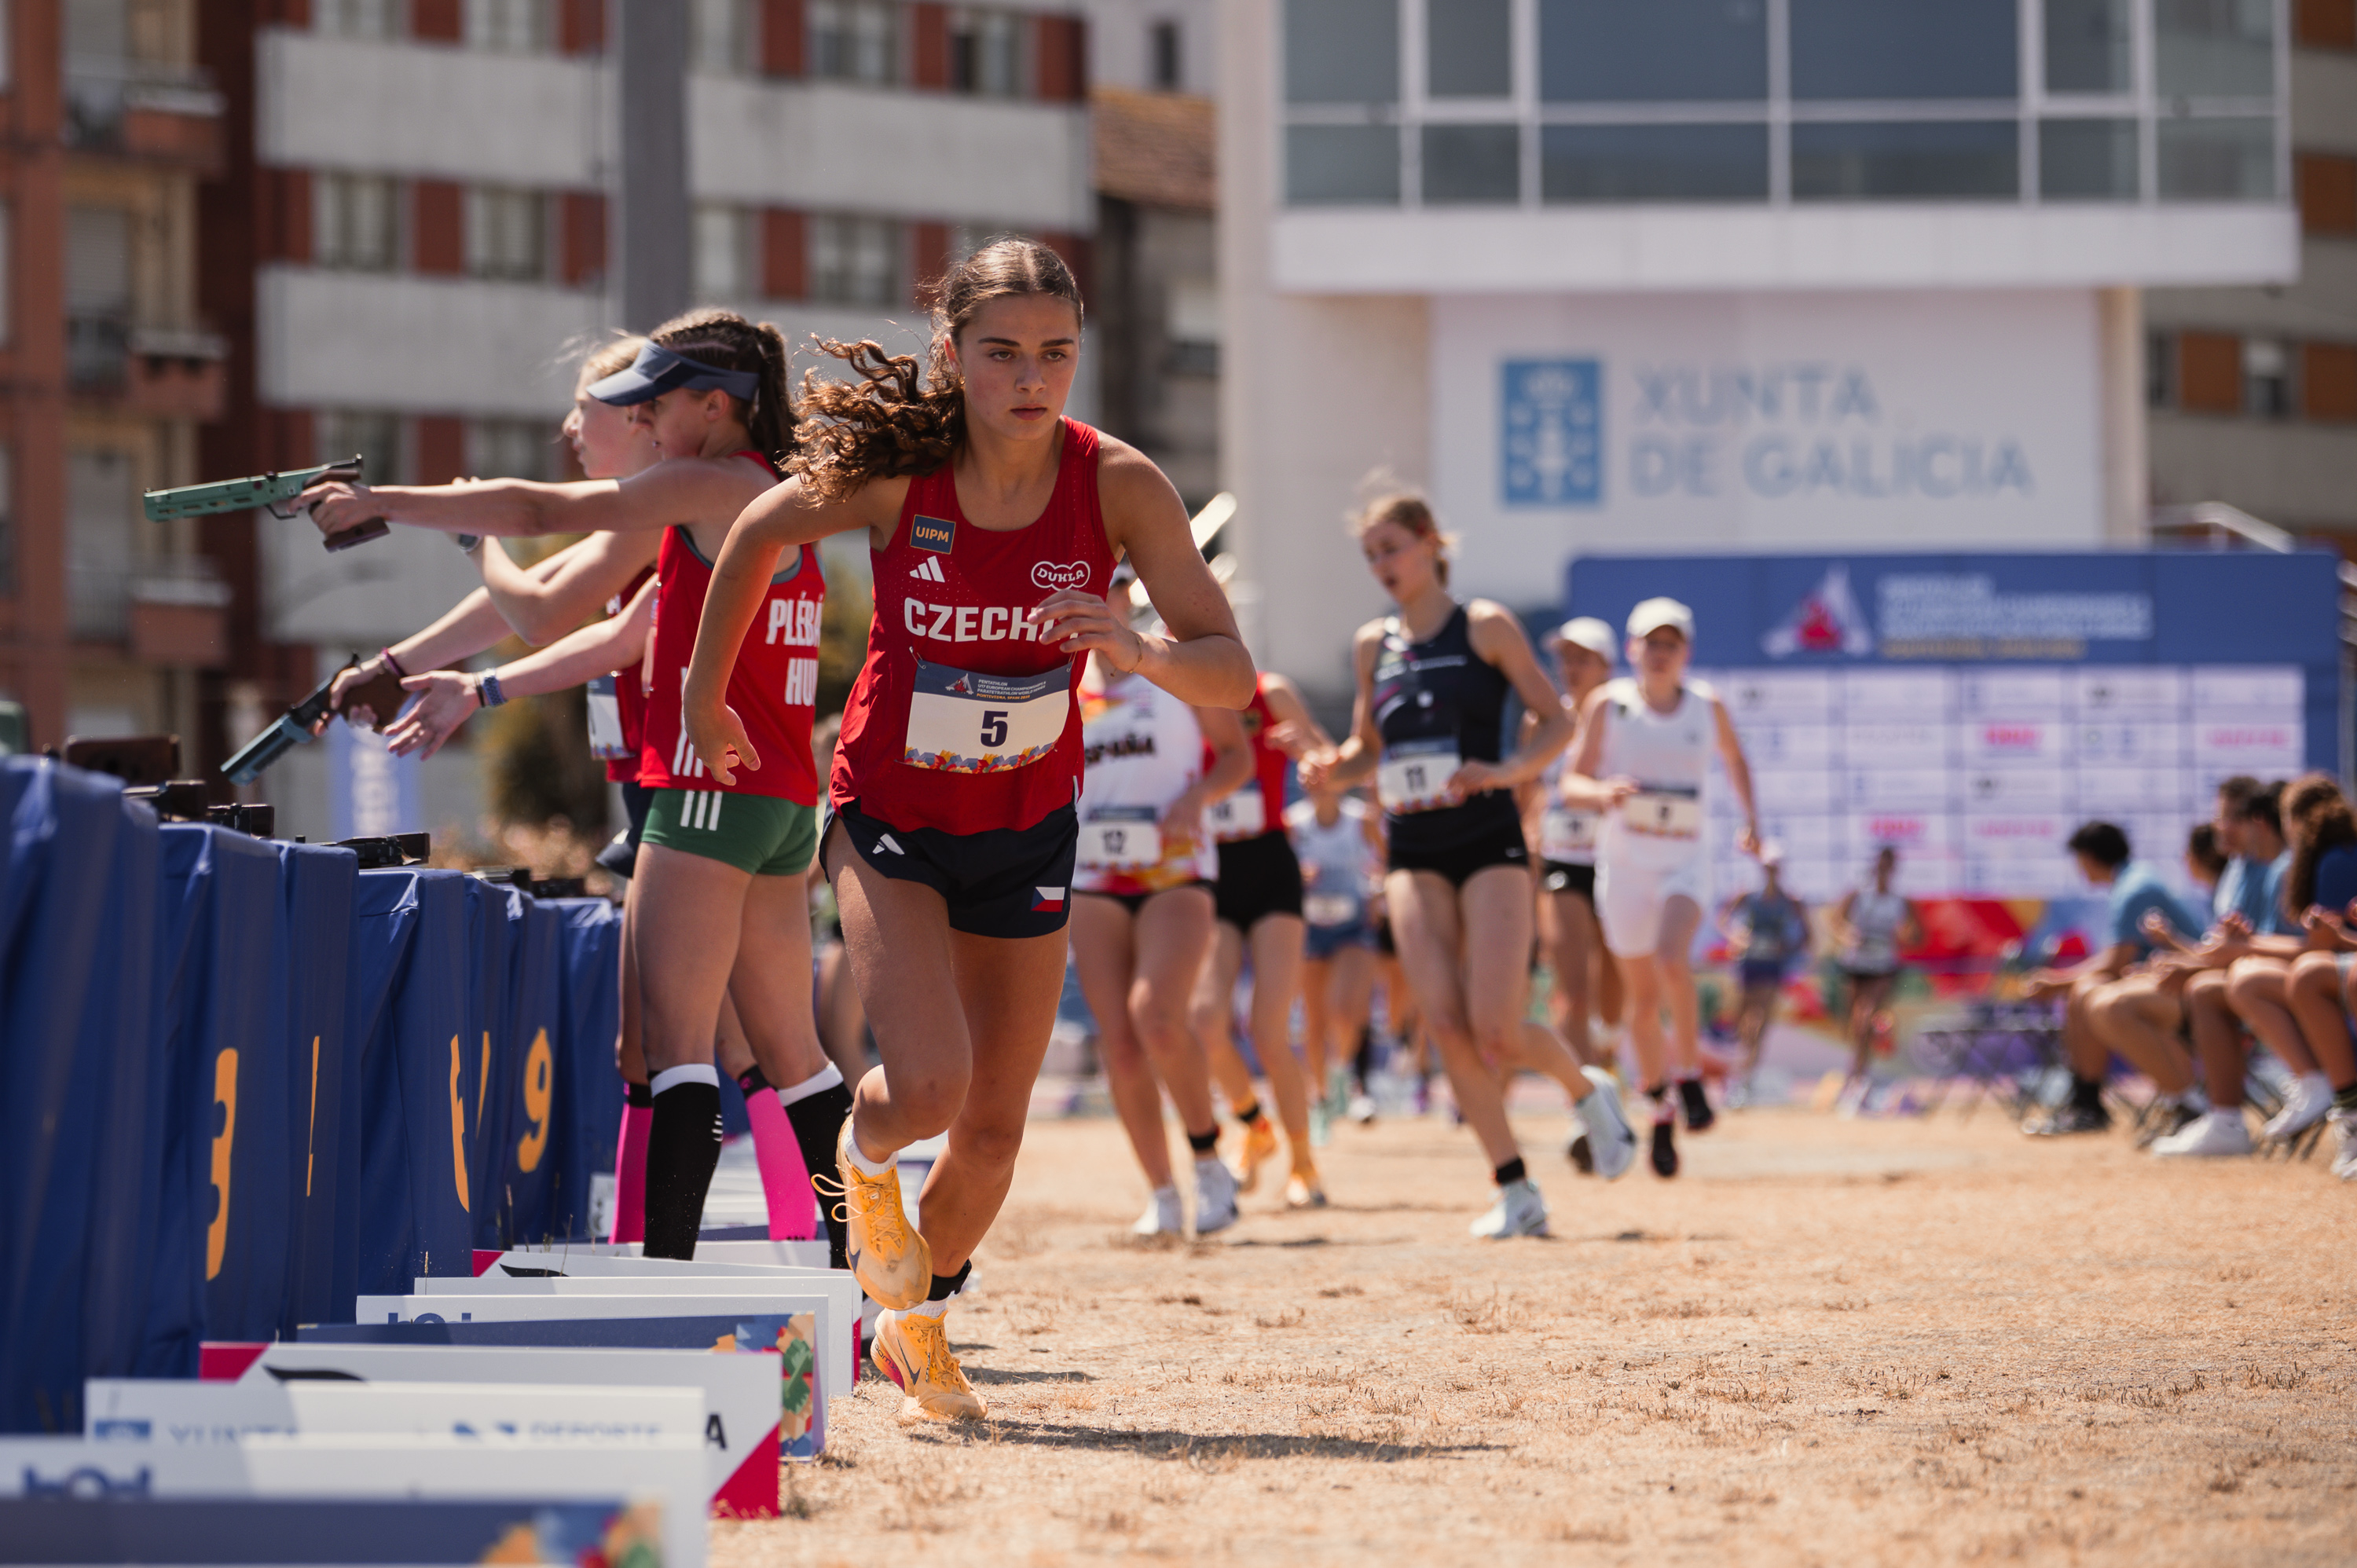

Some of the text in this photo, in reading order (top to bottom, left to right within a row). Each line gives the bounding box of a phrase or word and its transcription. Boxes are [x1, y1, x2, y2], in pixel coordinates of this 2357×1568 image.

[1633, 363, 1882, 425] XUNTA
[1629, 432, 2035, 498] DE GALICIA
[915, 526, 949, 543] UIPM
[904, 597, 1078, 643] CZECH
[980, 710, 1008, 748] 5
[516, 1026, 553, 1174] 9
